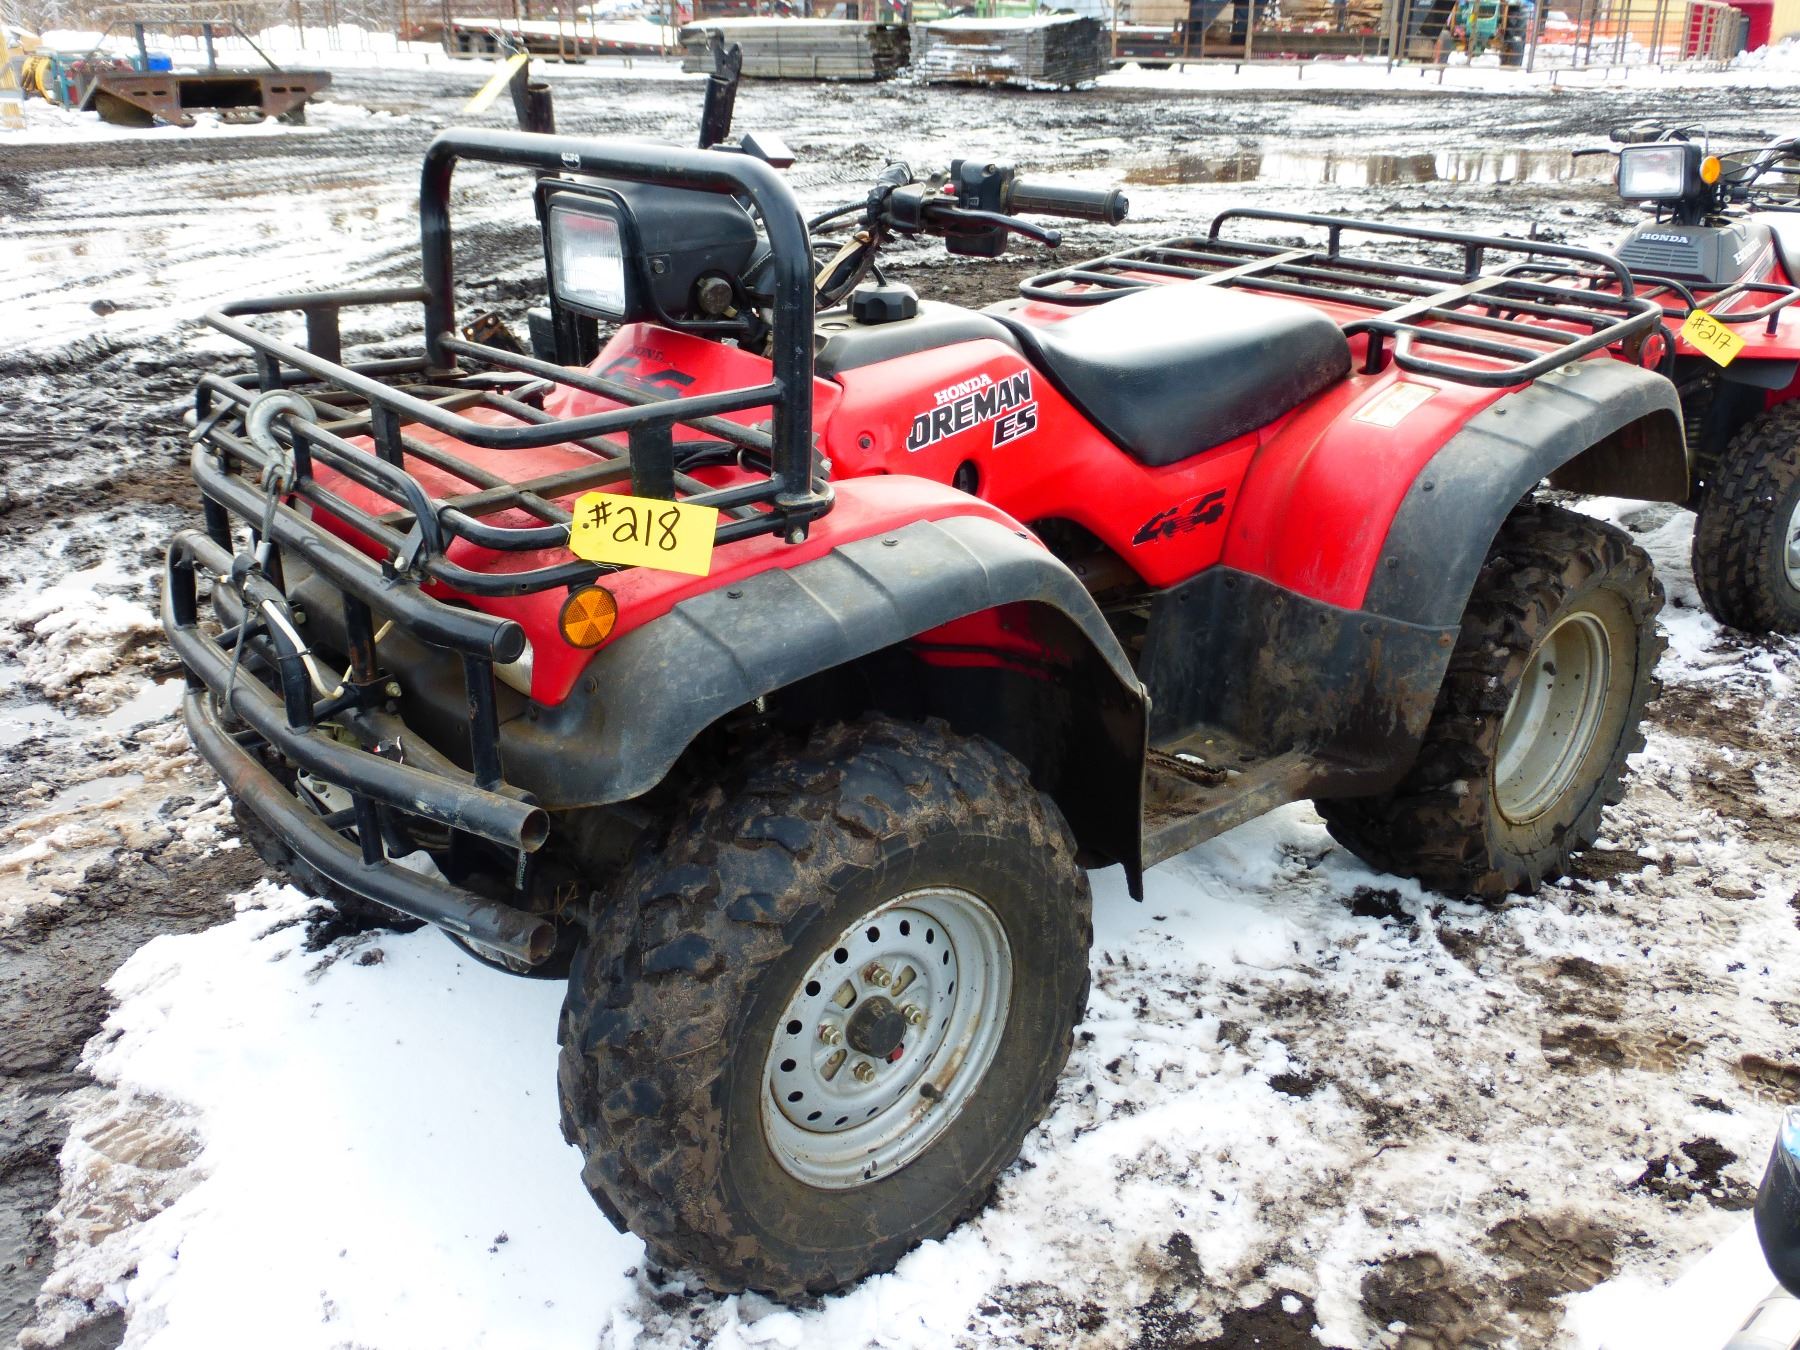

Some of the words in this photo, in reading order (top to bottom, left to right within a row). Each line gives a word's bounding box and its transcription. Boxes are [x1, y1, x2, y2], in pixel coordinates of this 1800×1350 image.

[1640, 232, 1689, 244] HONDA
[1690, 316, 1732, 350] #217
[933, 373, 993, 405] HONDA
[992, 401, 1038, 449] ES
[587, 501, 681, 551] #218
